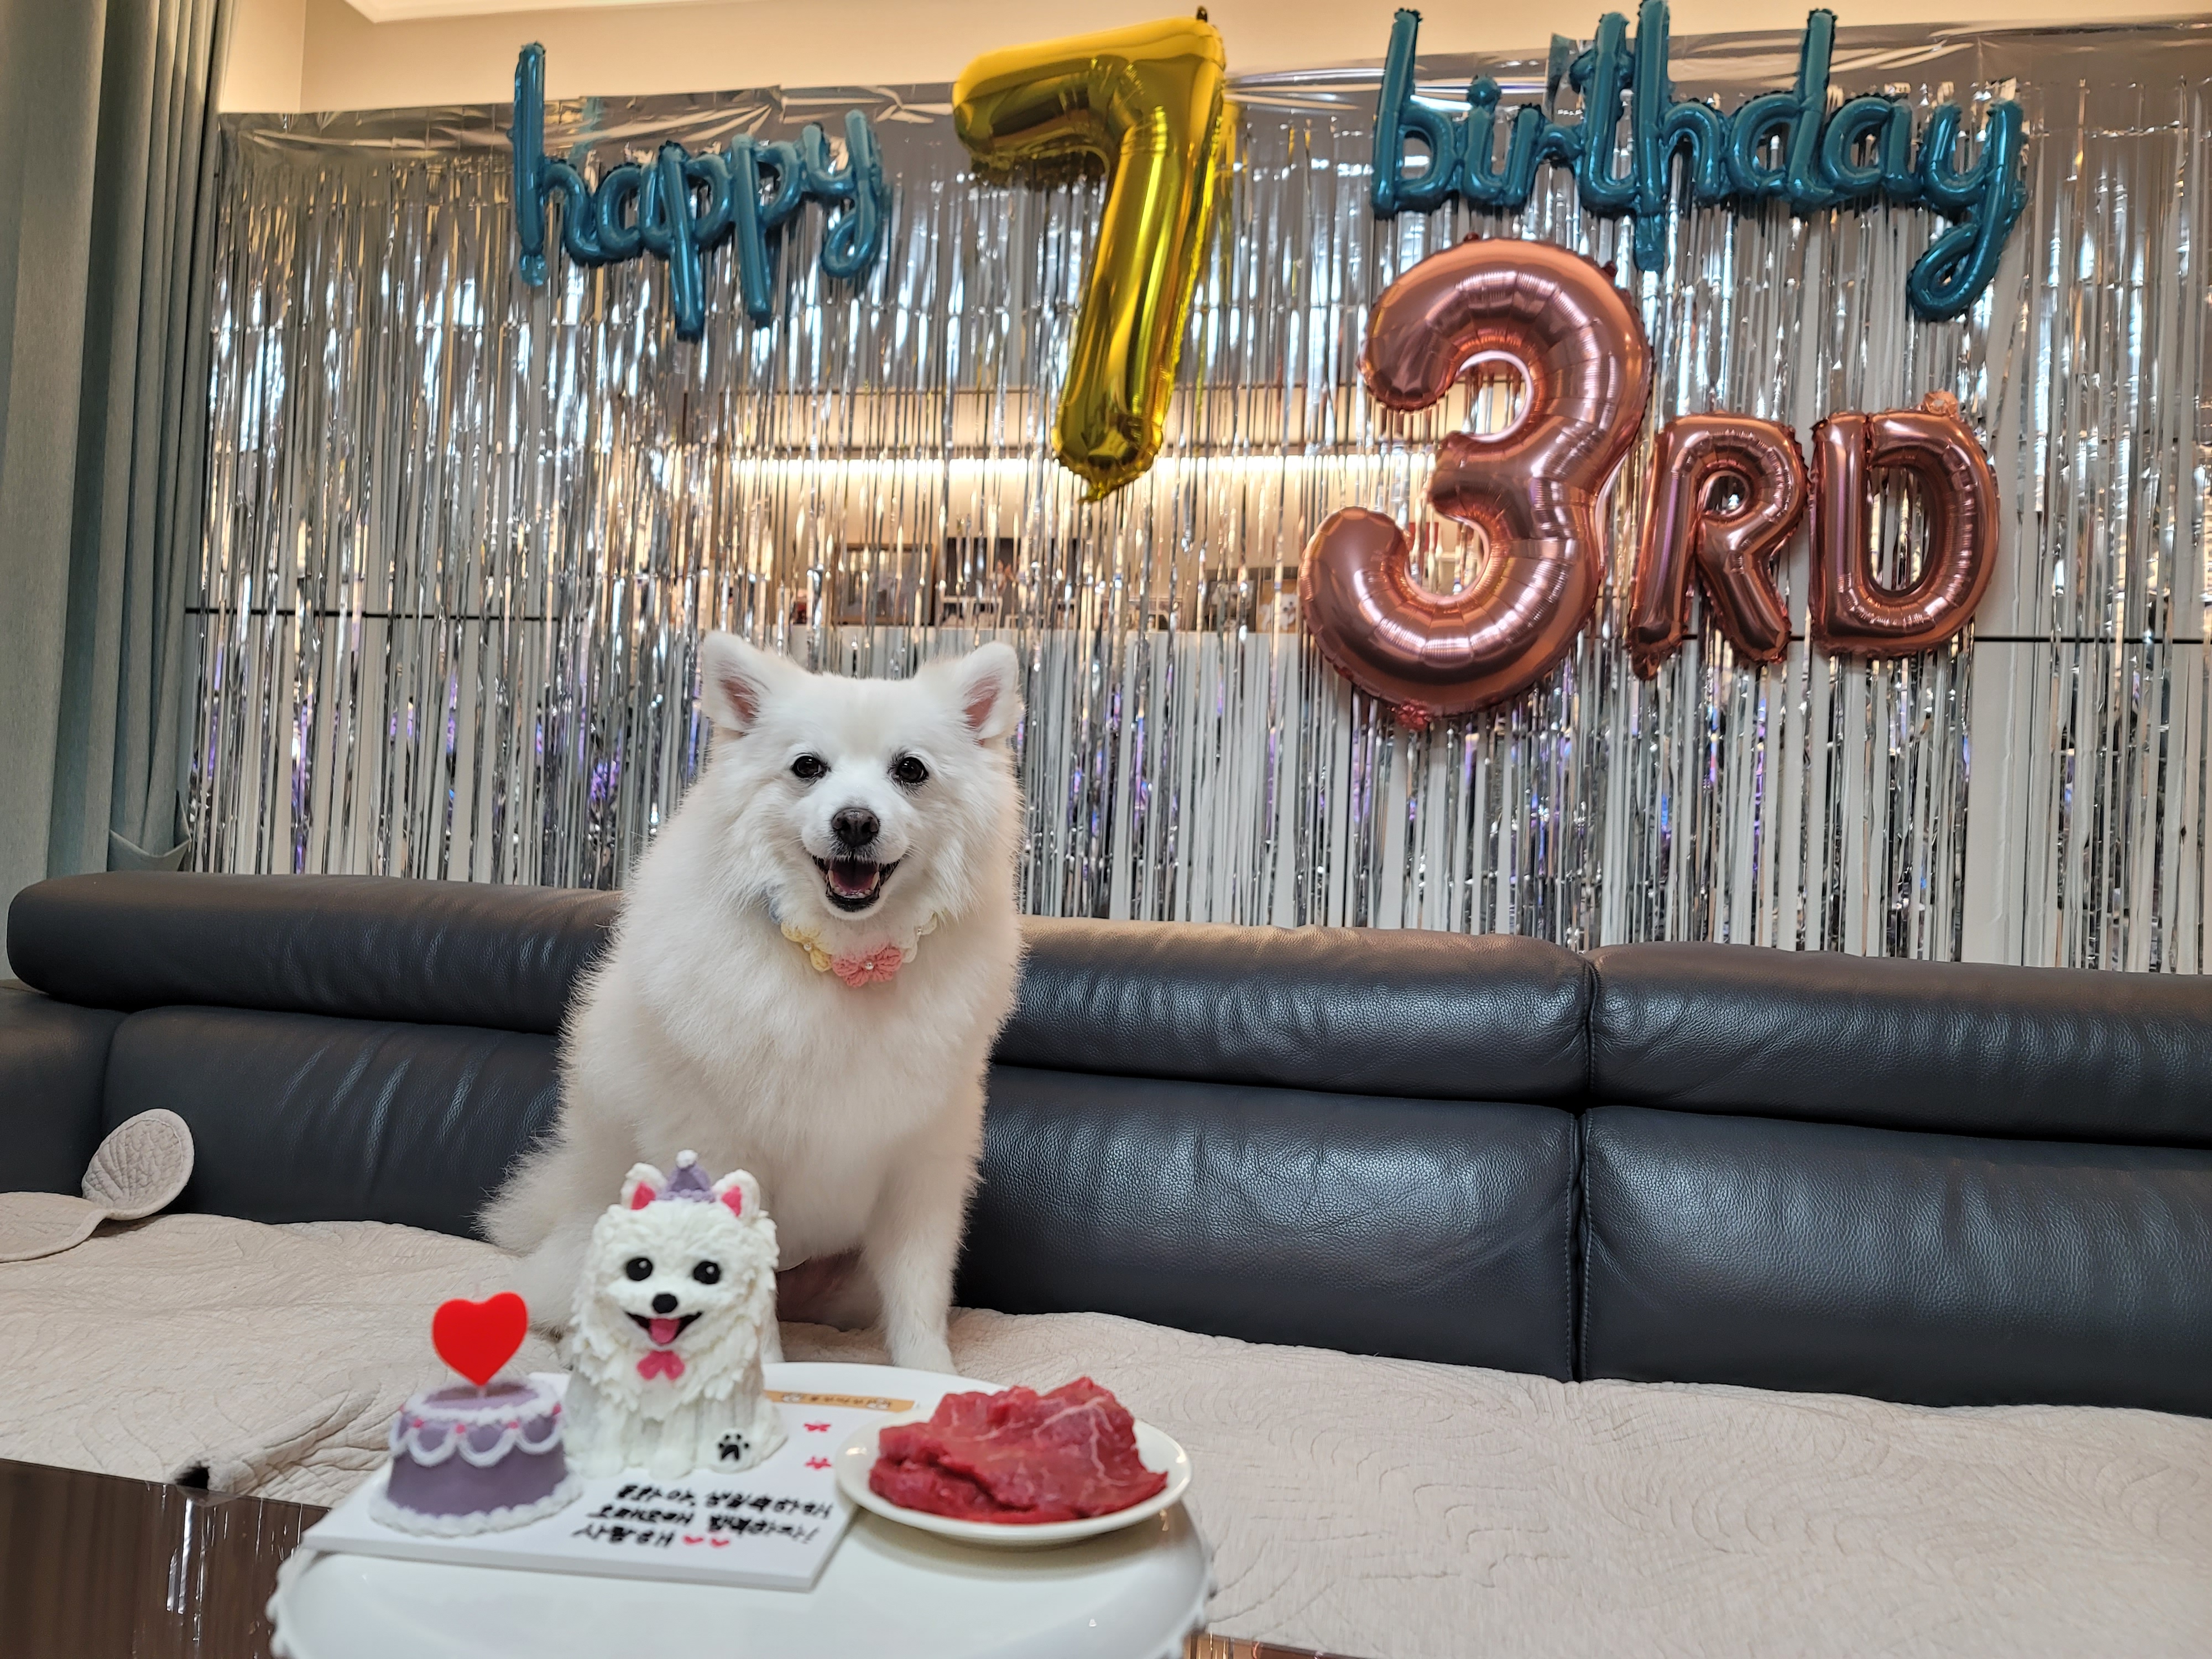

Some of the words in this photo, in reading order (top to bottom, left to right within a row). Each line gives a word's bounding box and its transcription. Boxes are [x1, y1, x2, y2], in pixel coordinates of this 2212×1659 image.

[509, 41, 886, 338] happy
[952, 4, 1227, 498] 7
[1371, 0, 2025, 321] birthday
